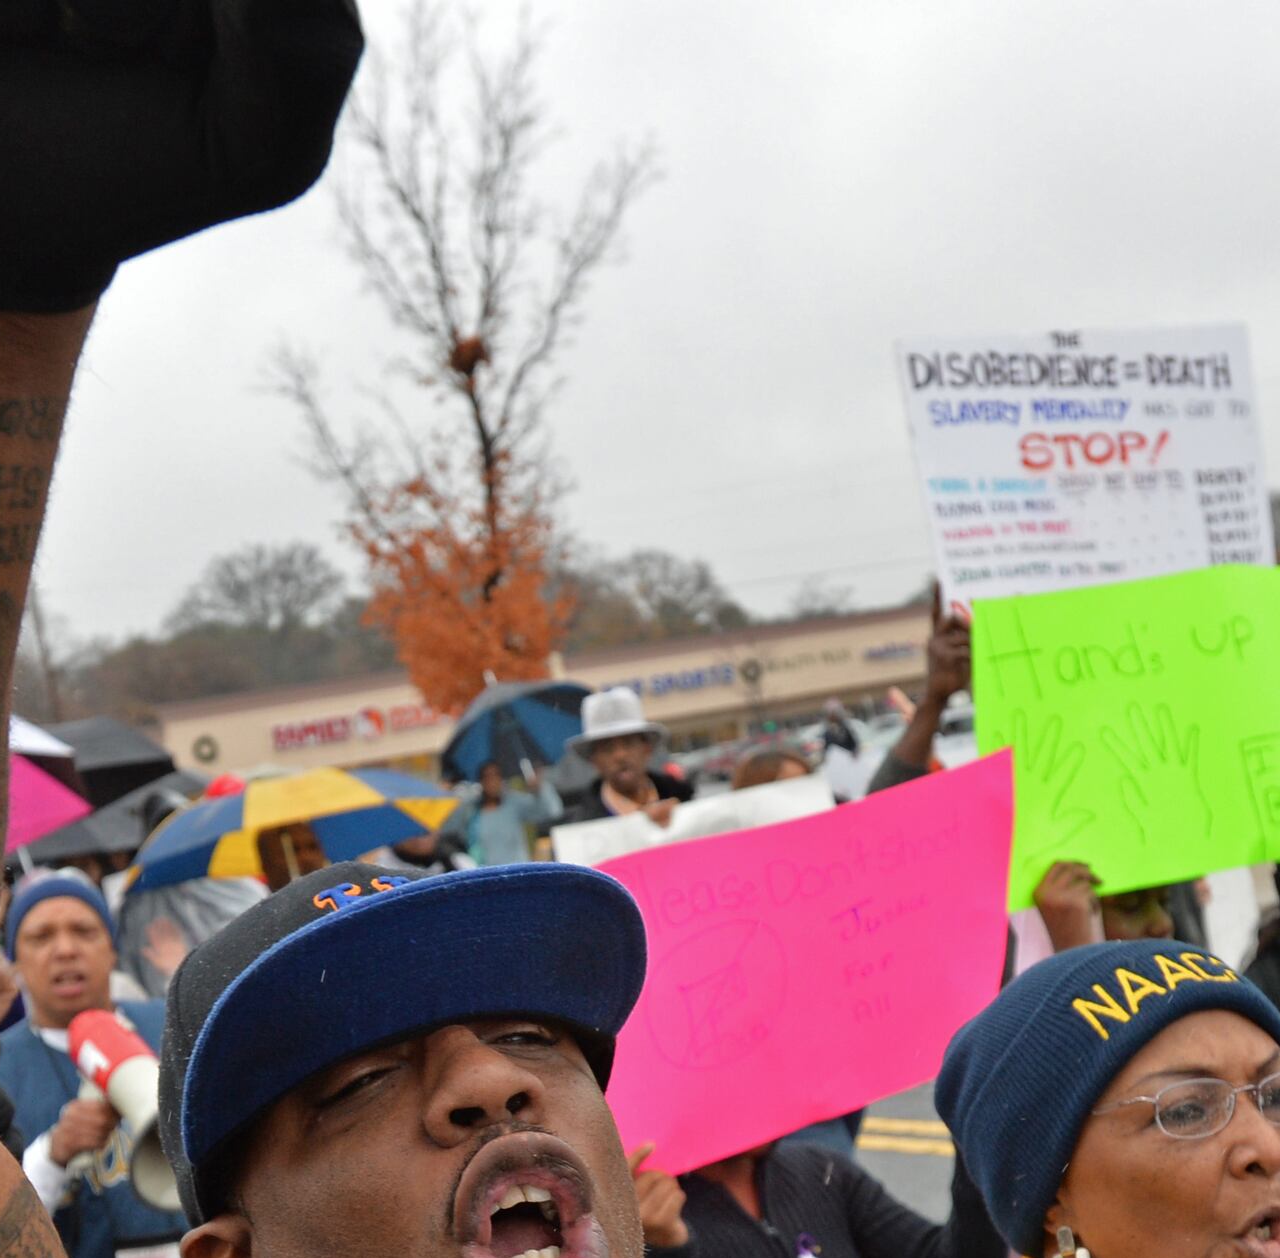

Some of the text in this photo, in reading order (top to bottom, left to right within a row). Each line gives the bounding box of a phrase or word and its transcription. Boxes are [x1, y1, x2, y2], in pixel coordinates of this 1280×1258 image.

[1049, 331, 1081, 350] THE
[907, 350, 1120, 391] DISOBEDIENCE
[1145, 352, 1232, 389] DEATH
[927, 400, 1020, 428] SLAVERY
[1019, 430, 1171, 471] STOP!
